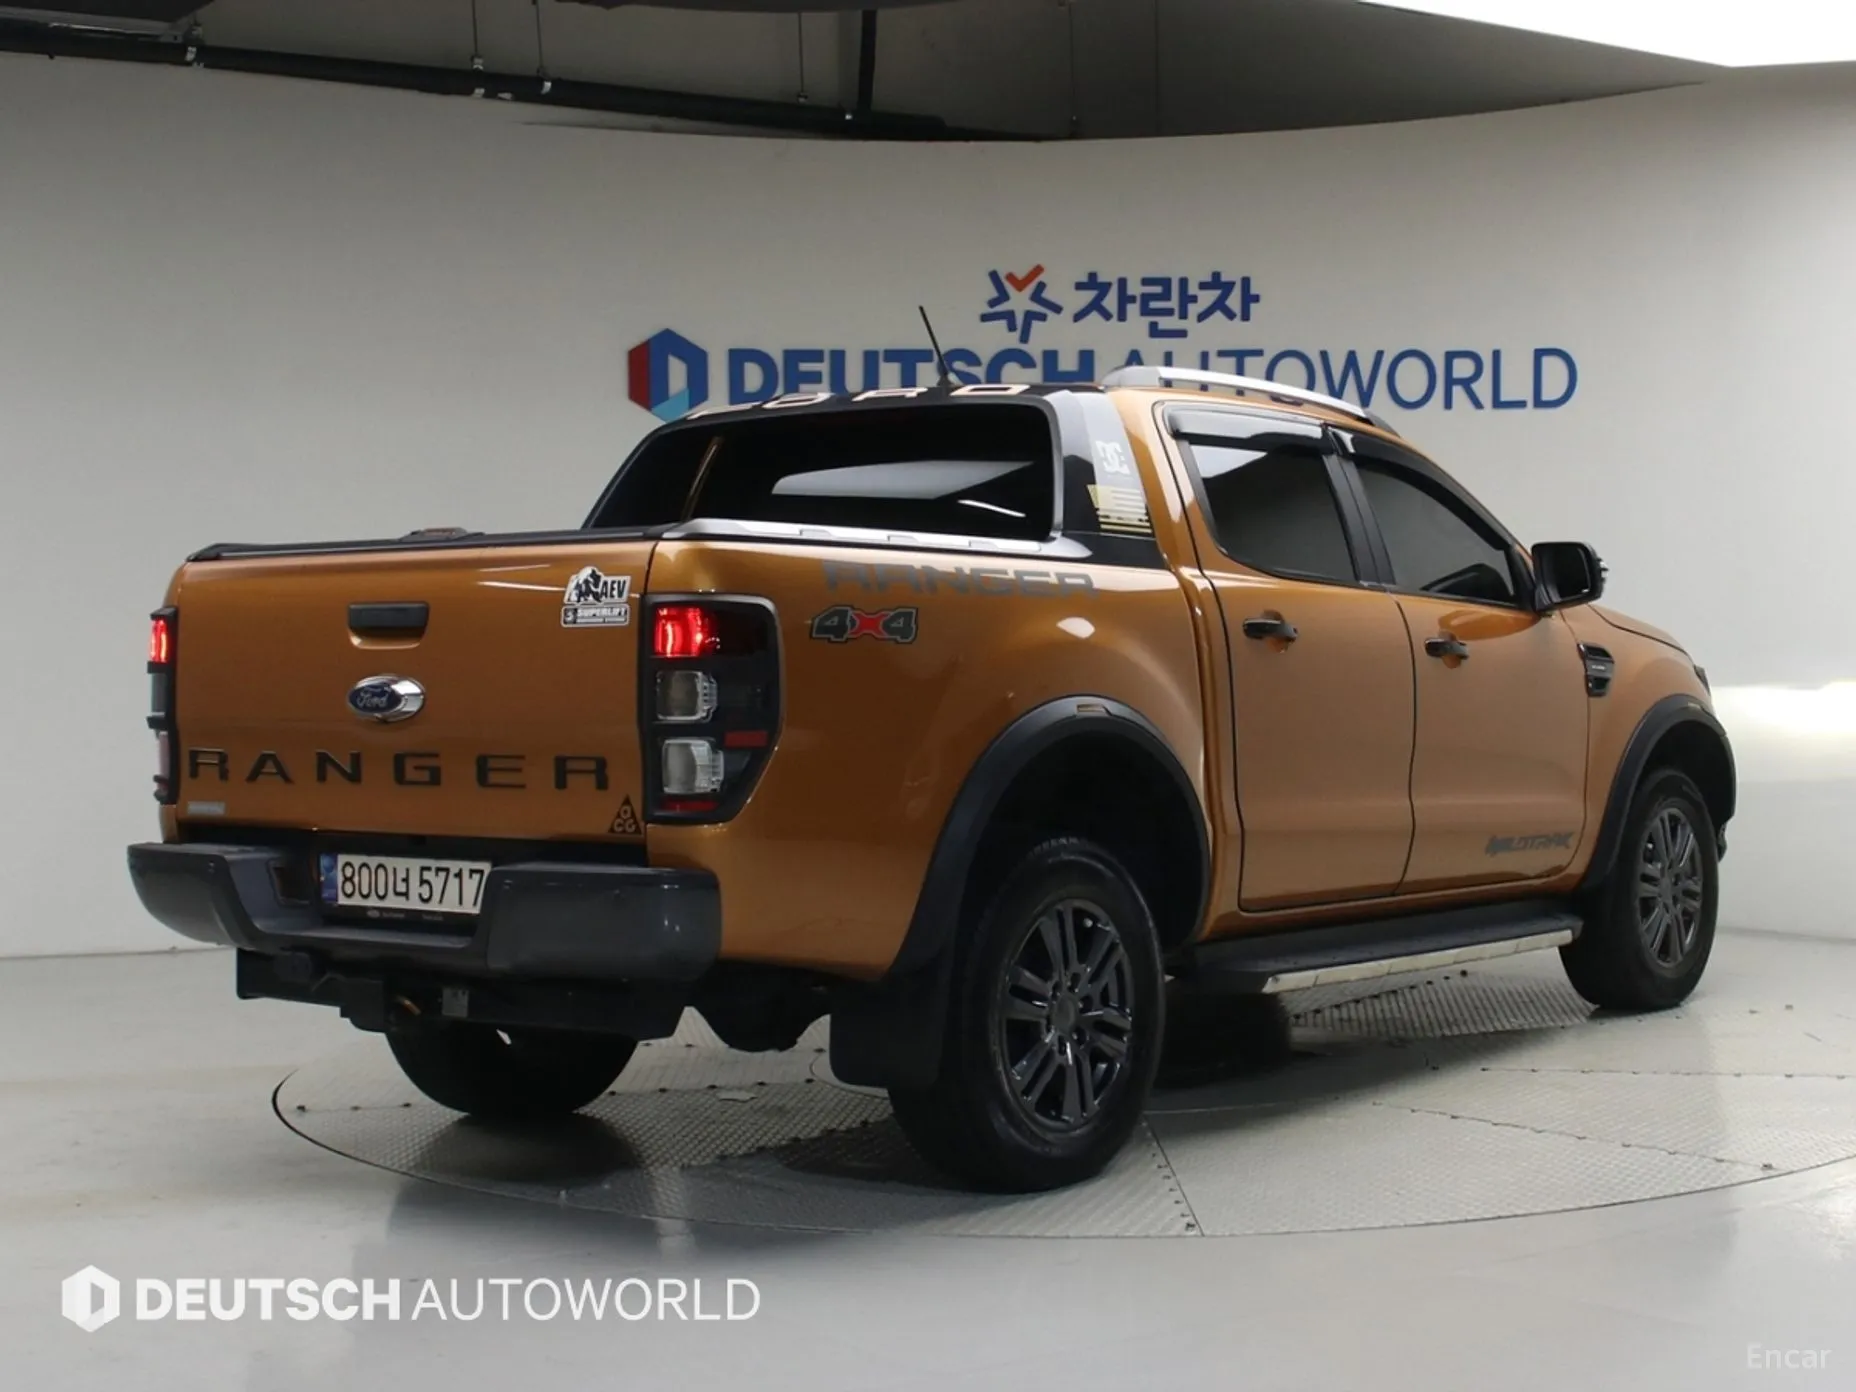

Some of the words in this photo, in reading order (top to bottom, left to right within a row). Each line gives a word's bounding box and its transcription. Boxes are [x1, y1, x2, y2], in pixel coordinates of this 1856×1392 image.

[1073, 271, 1260, 338] 차란차
[727, 347, 1096, 404] DEUTSCH
[600, 580, 626, 599] AEV
[822, 559, 1099, 598] RANGER
[188, 747, 610, 791] RANGER
